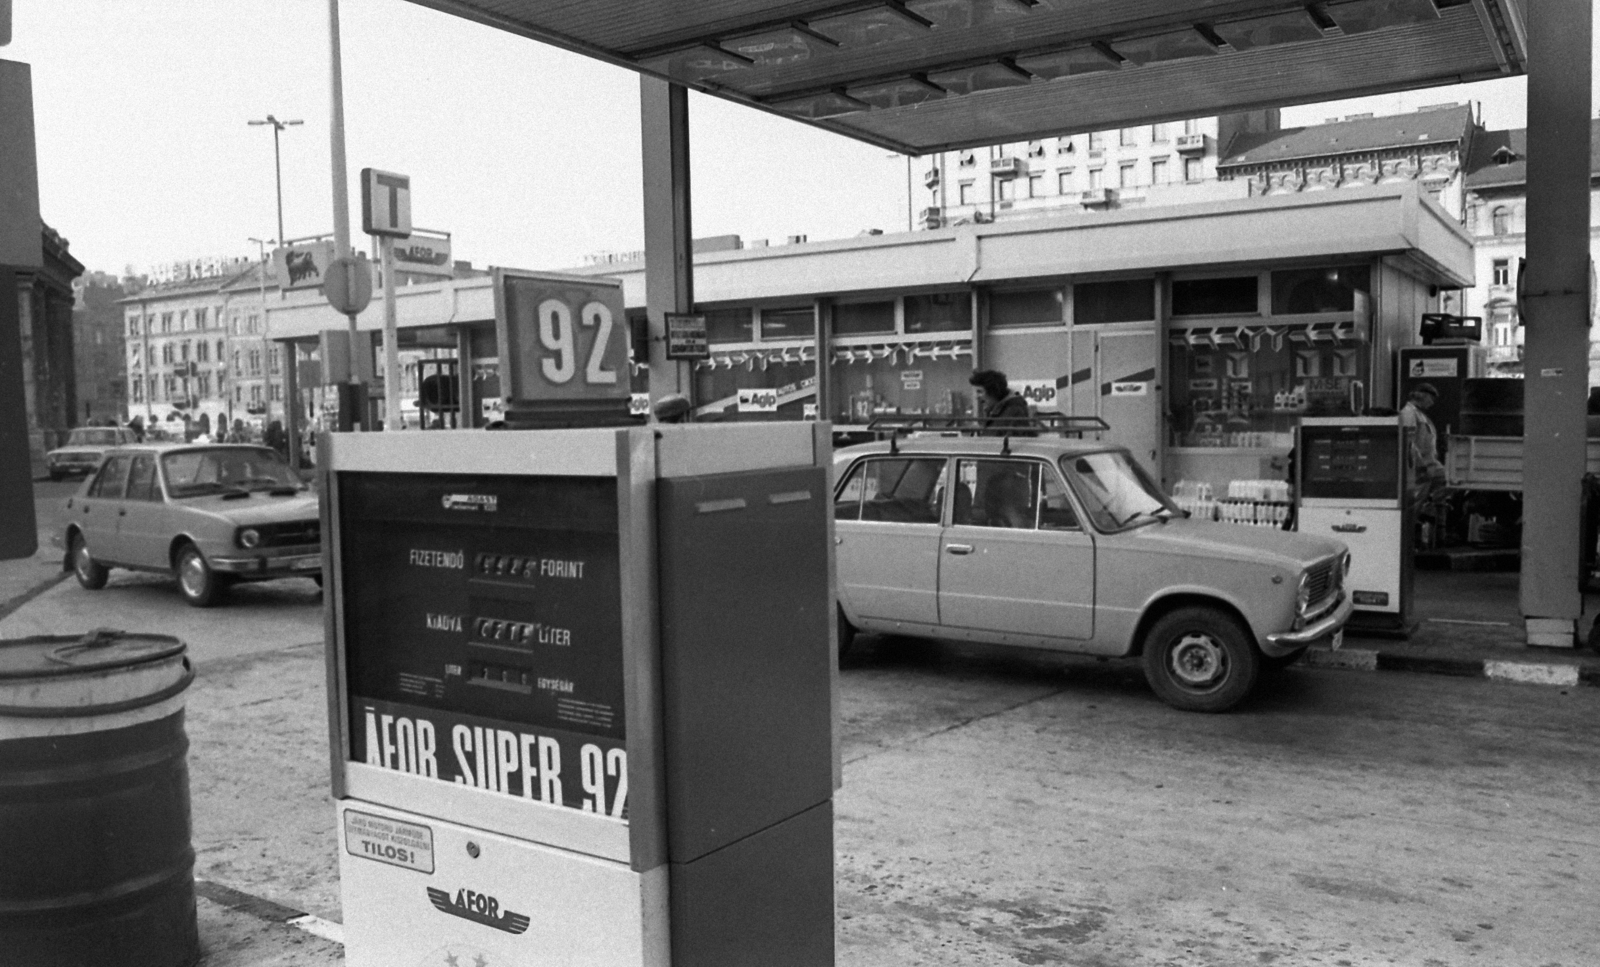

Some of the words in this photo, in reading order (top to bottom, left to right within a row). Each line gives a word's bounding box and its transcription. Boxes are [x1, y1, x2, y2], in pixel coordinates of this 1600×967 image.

[376, 173, 409, 228] T
[538, 299, 617, 384] 92
[751, 392, 777, 408] Agip
[1023, 384, 1056, 402] Agip
[540, 559, 585, 578] FORINT
[364, 706, 439, 779] ÁFOR
[452, 724, 563, 806] SUPER
[580, 743, 628, 820] 92
[362, 840, 415, 864] TILOS!
[455, 888, 499, 919] ÁFOR
